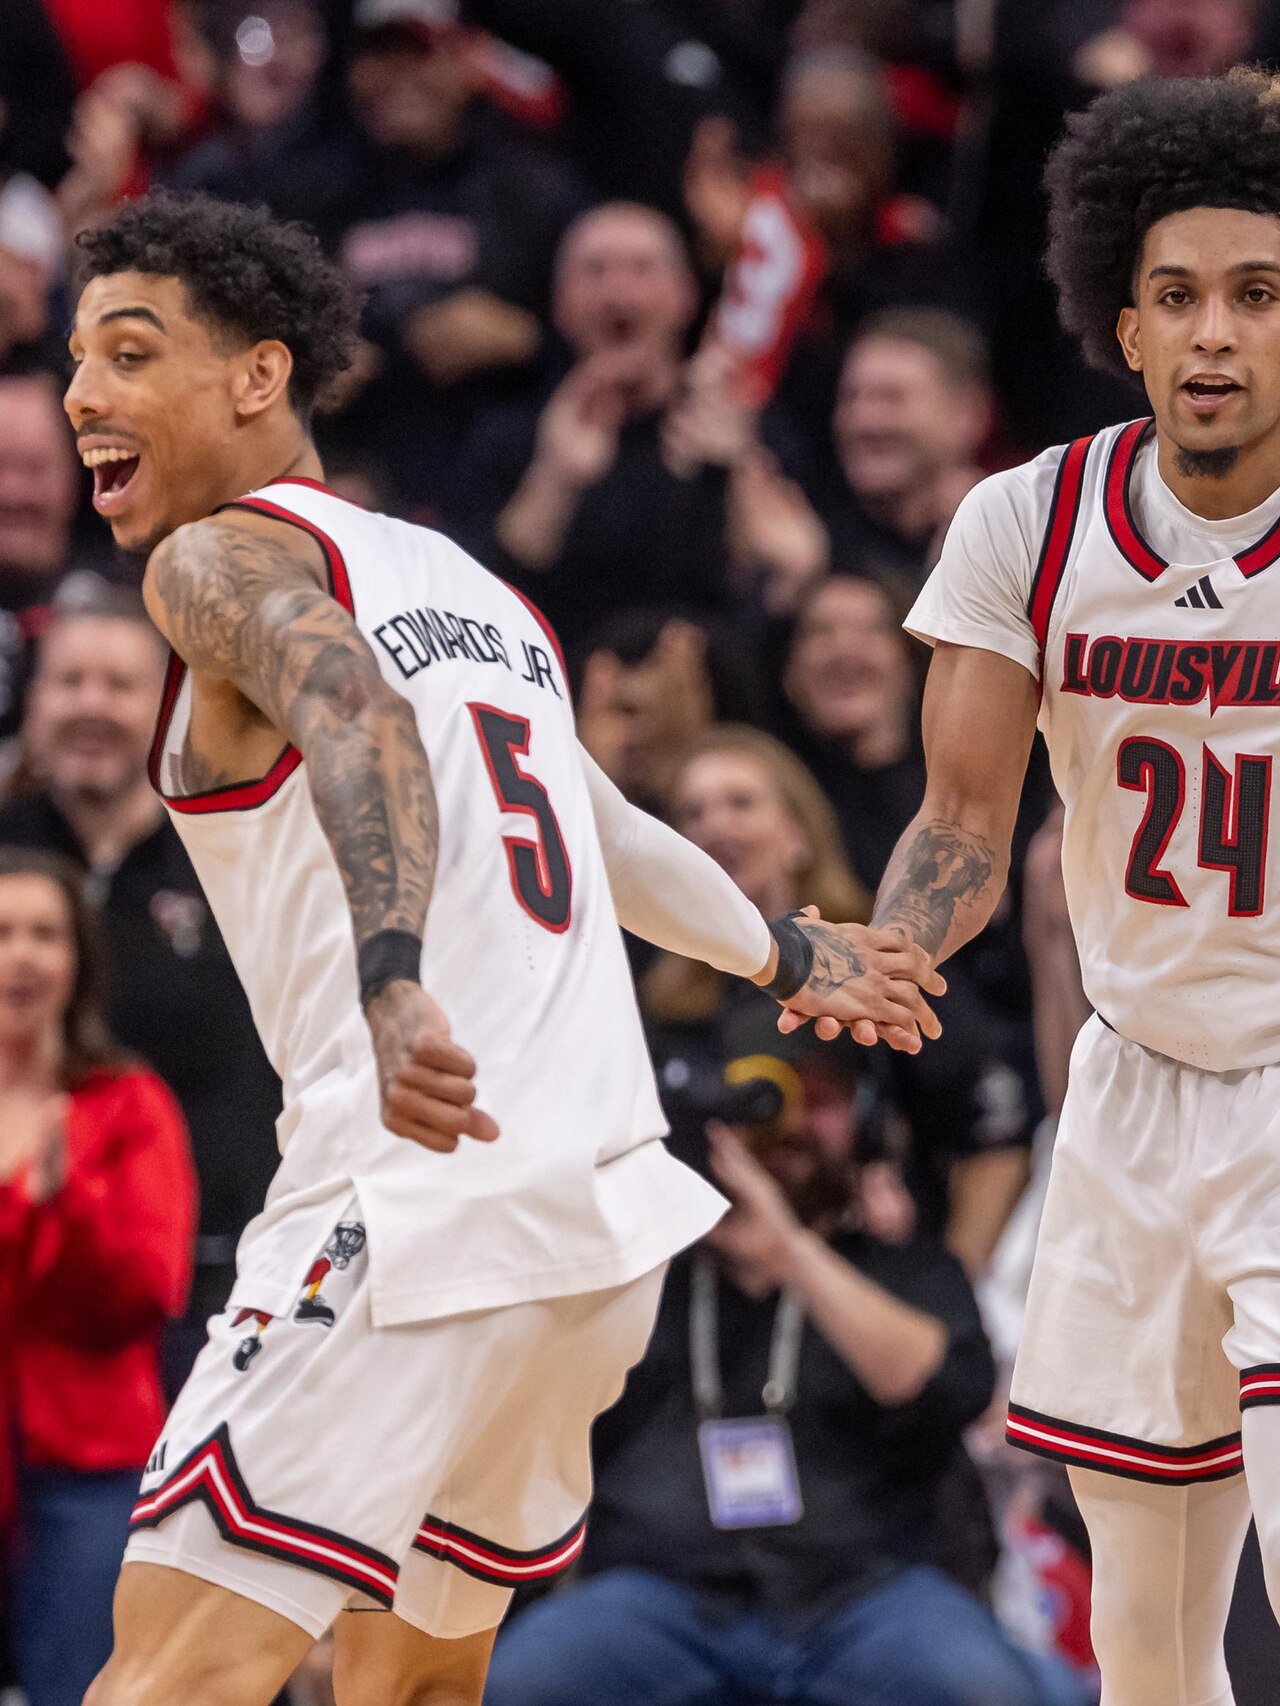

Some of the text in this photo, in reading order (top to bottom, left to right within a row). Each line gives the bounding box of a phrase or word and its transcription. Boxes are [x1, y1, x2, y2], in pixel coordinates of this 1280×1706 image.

[371, 606, 512, 680] EDWARDS
[464, 702, 572, 935] 5
[1116, 735, 1273, 918] 24
